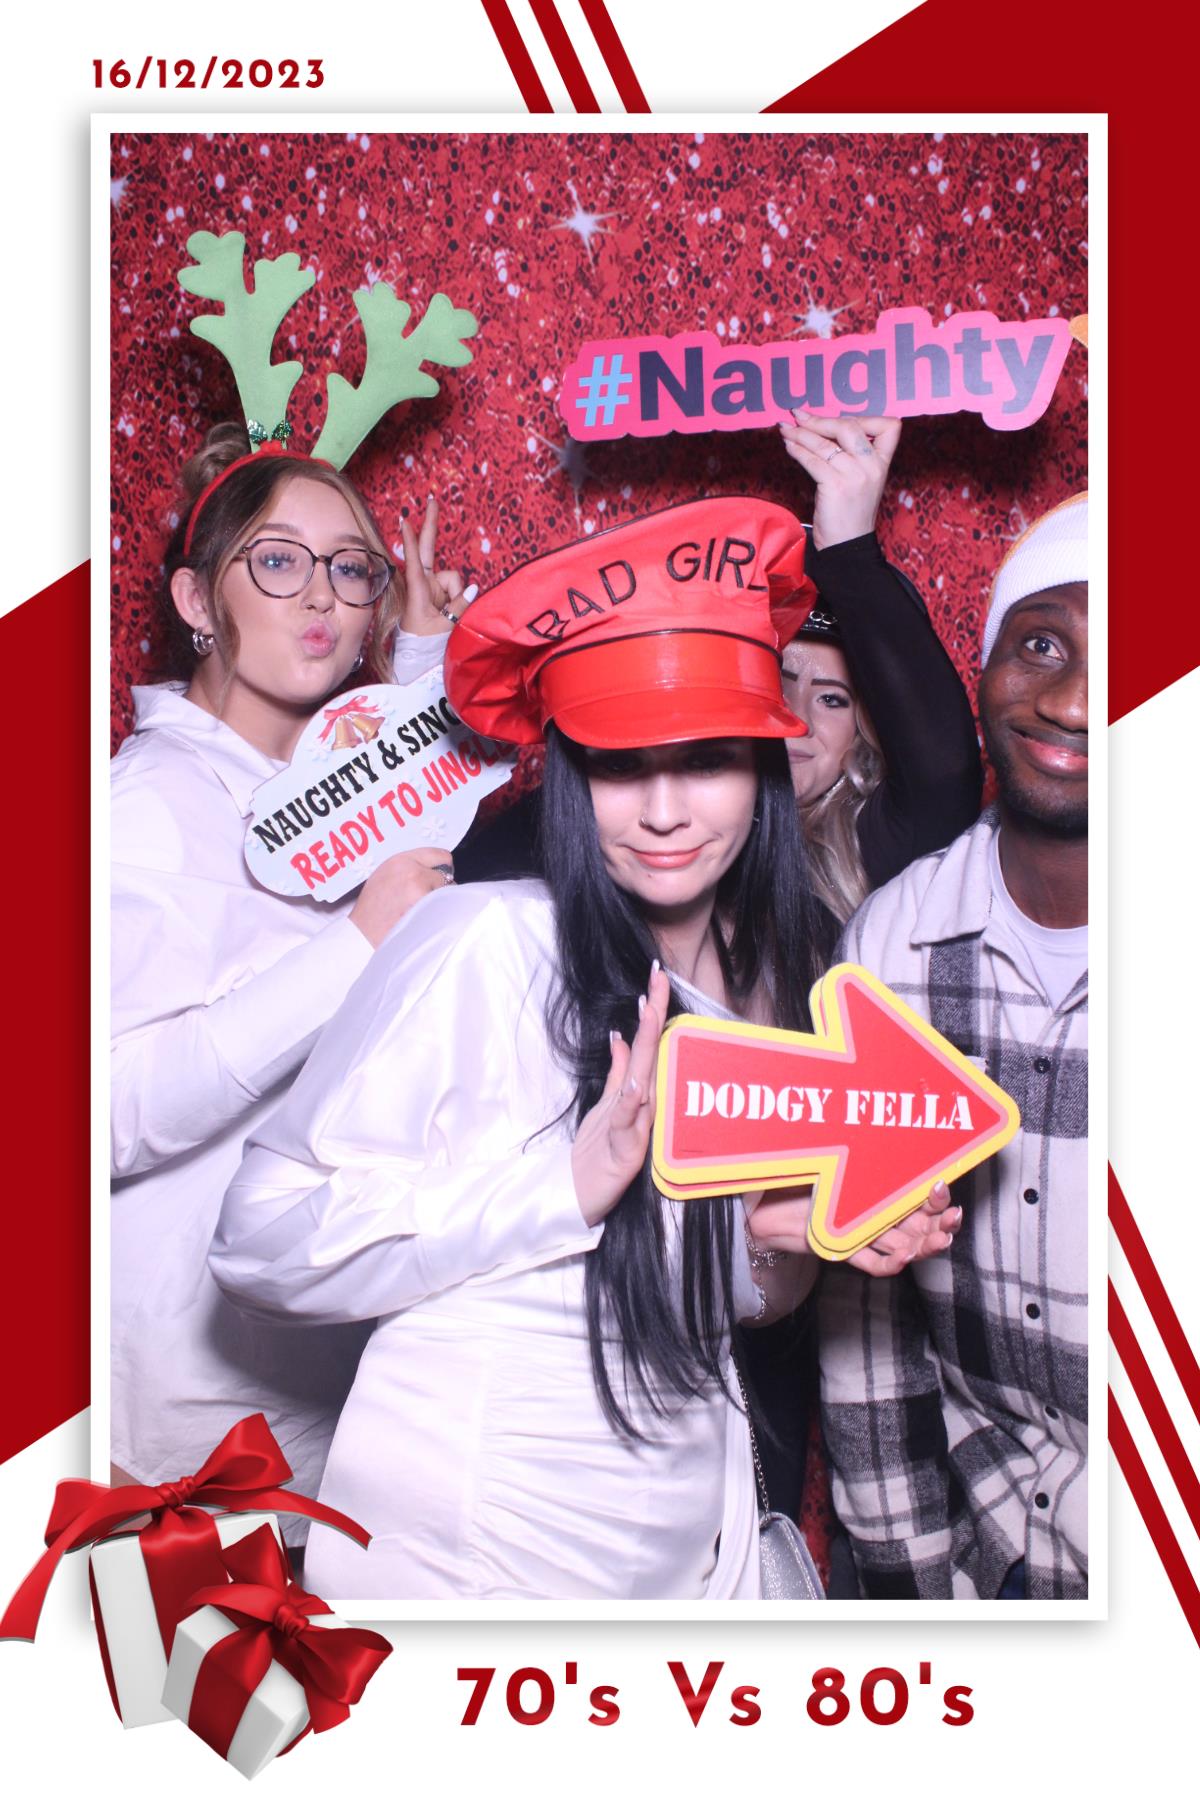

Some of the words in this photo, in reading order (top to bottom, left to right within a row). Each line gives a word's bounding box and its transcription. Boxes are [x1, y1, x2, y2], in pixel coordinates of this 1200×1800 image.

[576, 323, 1056, 426] #Naughty
[526, 560, 637, 641] BAD
[252, 752, 380, 854] NAUGHTY
[377, 740, 405, 770] &
[290, 806, 385, 890] READY
[378, 782, 424, 828] TO
[685, 1081, 832, 1123] DODGY
[844, 1089, 975, 1131] FELLA
